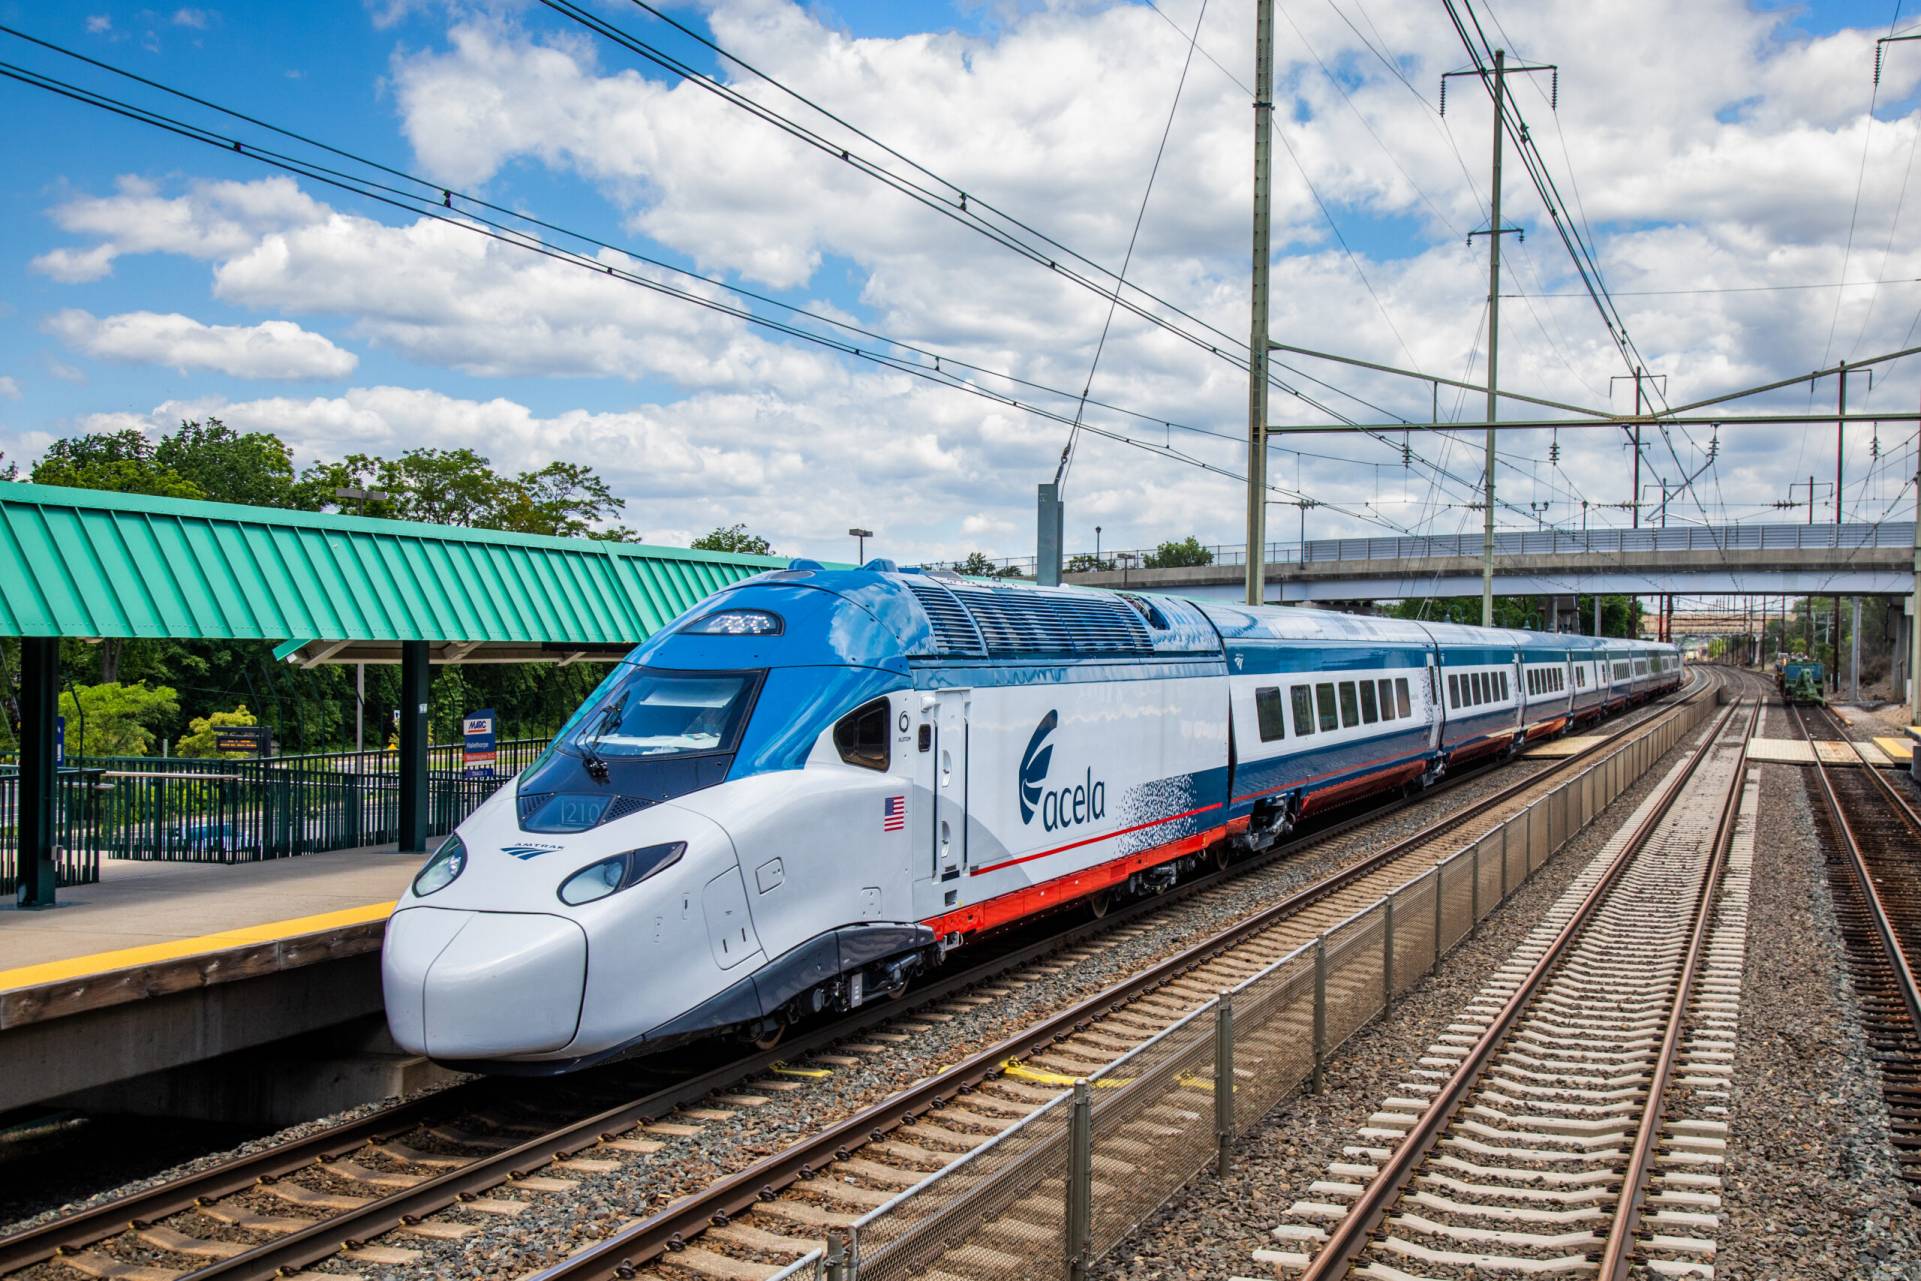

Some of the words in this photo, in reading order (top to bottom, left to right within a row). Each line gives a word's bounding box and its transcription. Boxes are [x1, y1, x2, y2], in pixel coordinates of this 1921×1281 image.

[468, 720, 487, 729] MARC
[1043, 765, 1105, 832] acela
[514, 842, 565, 850] AMTRAK
